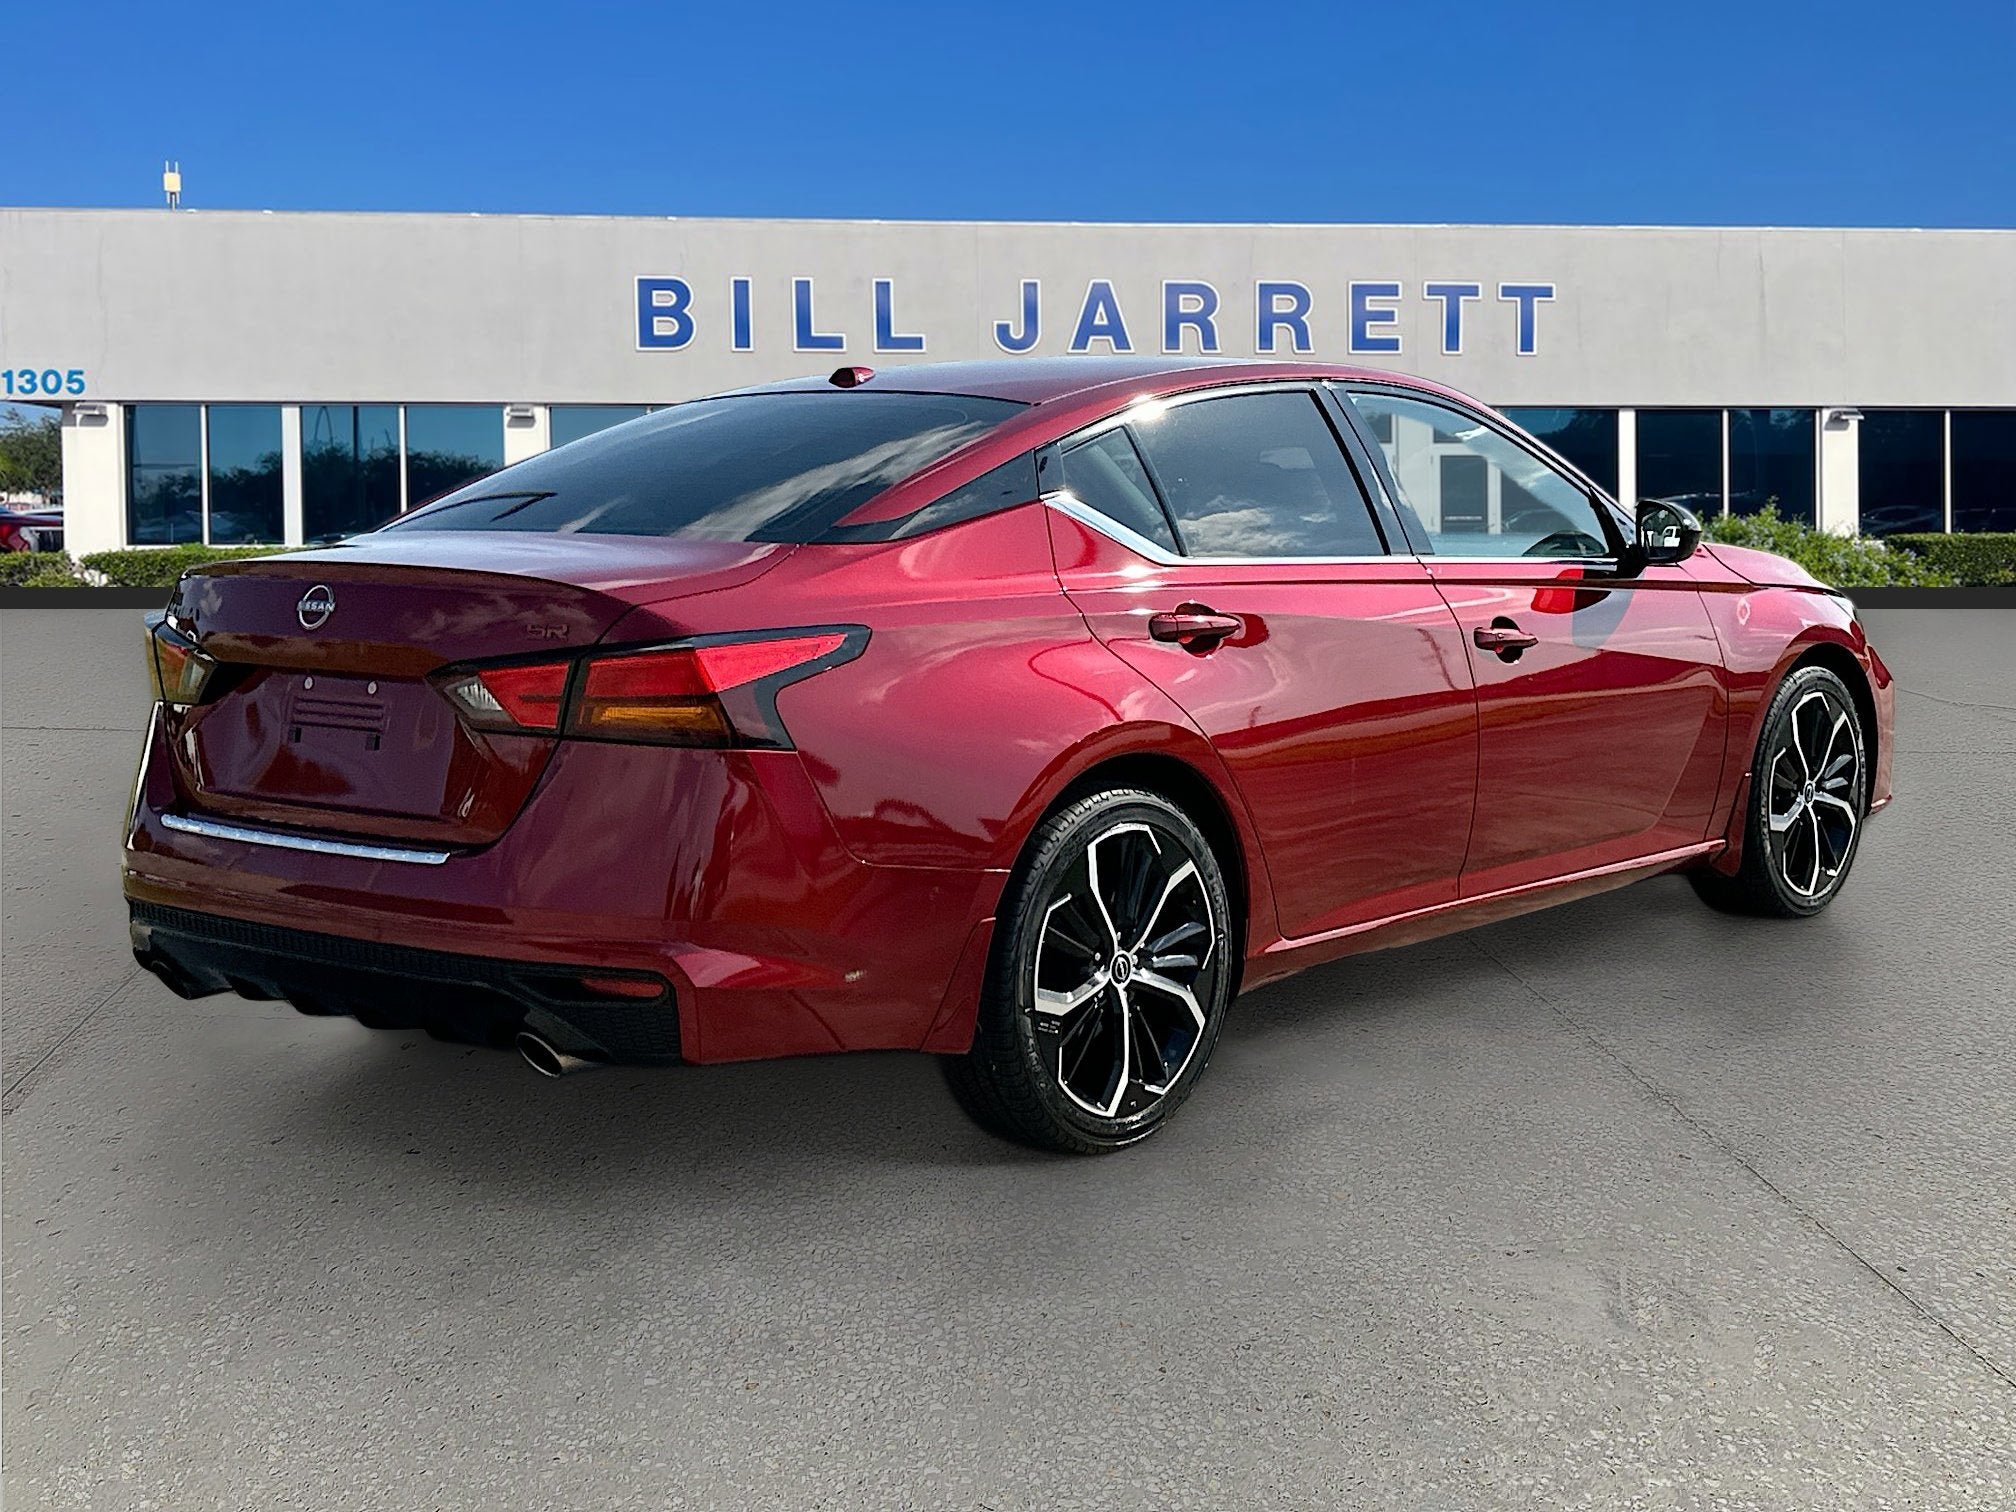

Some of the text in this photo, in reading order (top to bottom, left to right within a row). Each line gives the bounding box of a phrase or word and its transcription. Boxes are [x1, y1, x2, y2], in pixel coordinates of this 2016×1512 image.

[635, 276, 1556, 356] BILL JARRETT
[1, 368, 86, 395] 1305
[527, 623, 569, 641] SR
